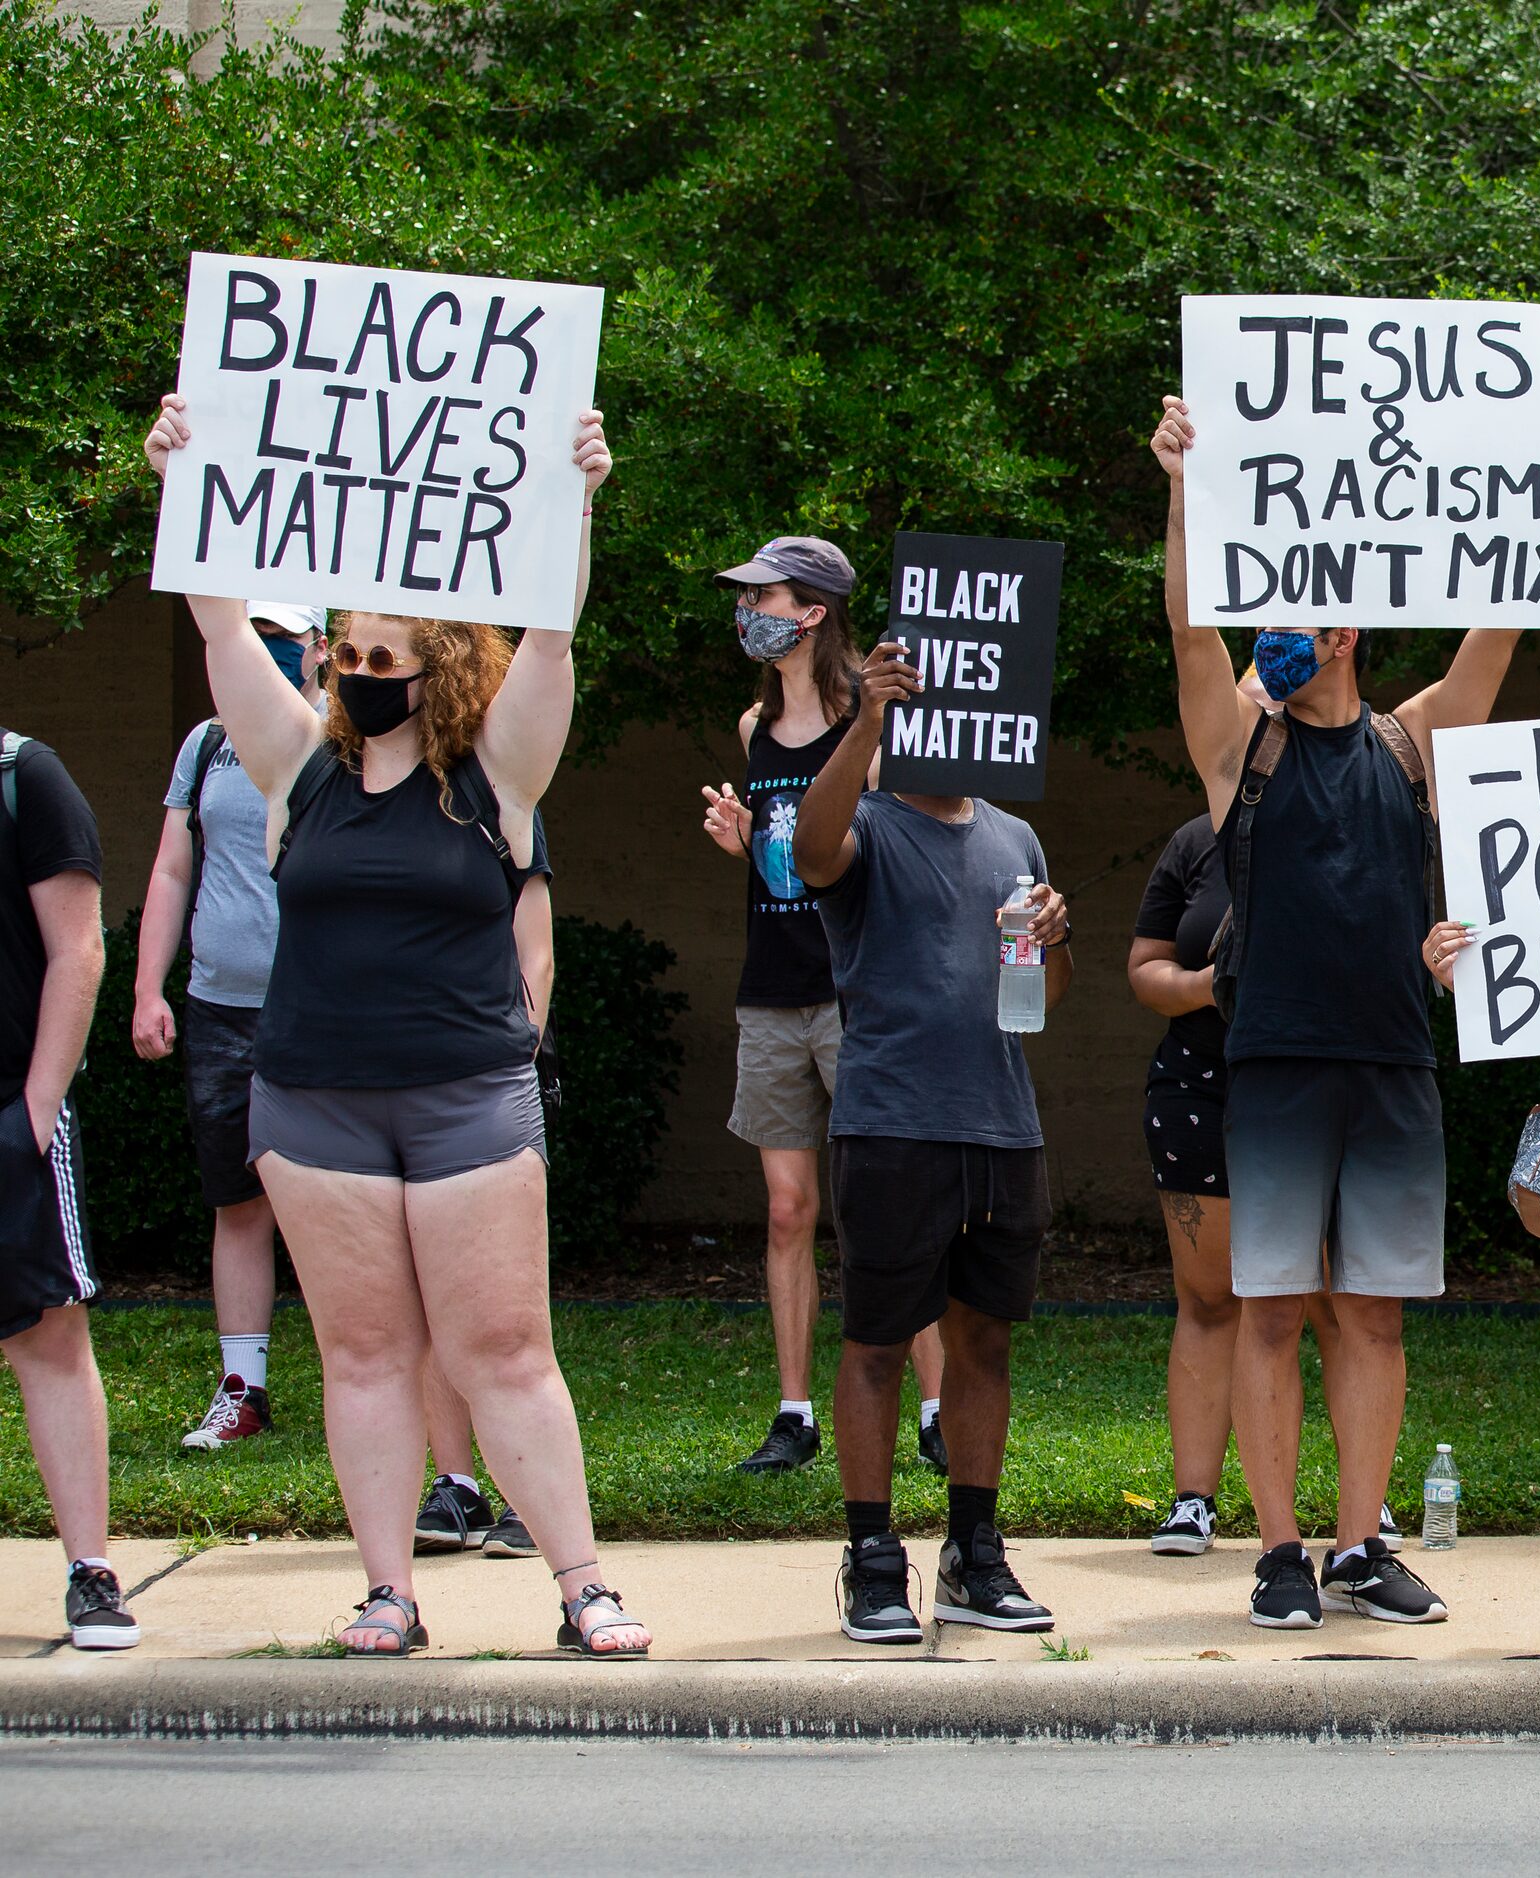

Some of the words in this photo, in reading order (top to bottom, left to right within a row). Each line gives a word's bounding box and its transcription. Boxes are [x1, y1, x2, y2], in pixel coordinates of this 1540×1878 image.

[219, 270, 545, 394] BLACK
[1235, 316, 1533, 421] JESUS
[257, 379, 527, 493] LIVES
[1369, 404, 1422, 466] &
[195, 463, 511, 596] MATTER
[900, 566, 1024, 623] BLACK
[1215, 541, 1423, 613] DON'T
[892, 706, 1039, 764] MATTER
